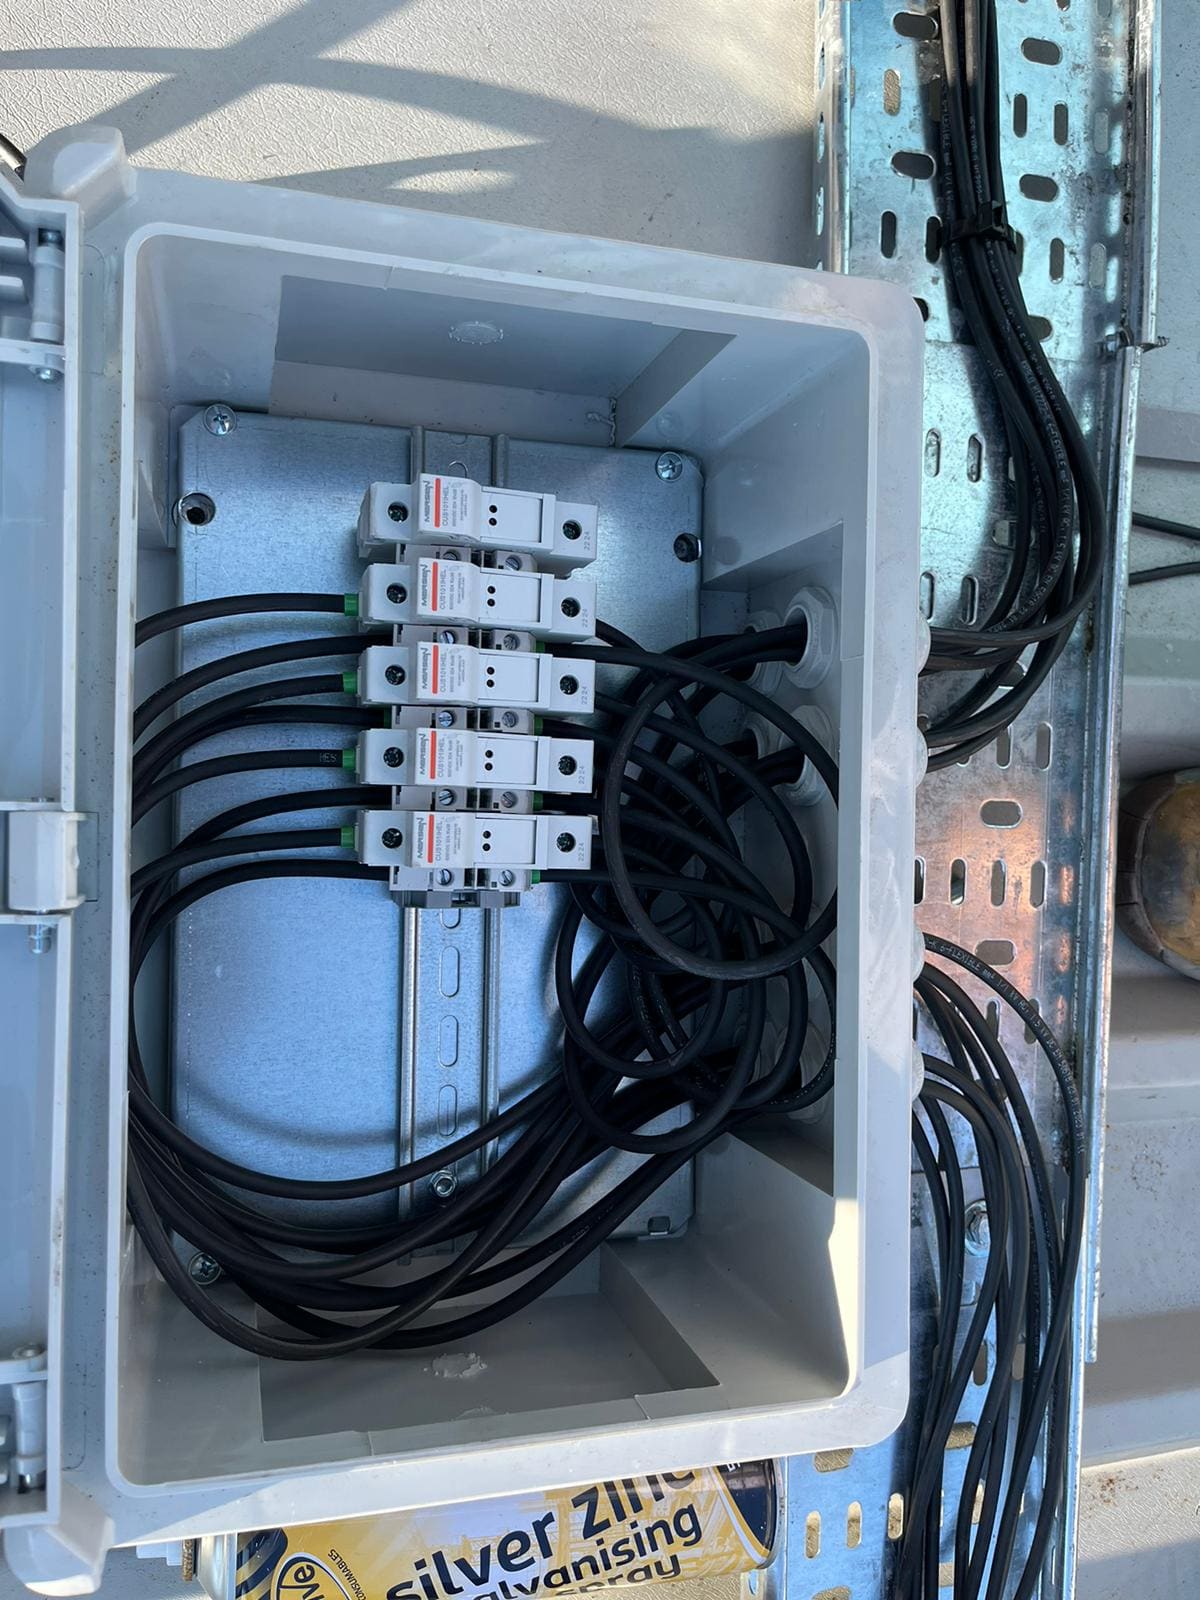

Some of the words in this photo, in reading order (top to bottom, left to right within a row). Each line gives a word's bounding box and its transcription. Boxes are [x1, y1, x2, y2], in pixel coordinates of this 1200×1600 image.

[423, 480, 433, 523] MERSEN
[420, 563, 431, 606] MERSEN
[420, 647, 431, 689] MERSEN
[418, 733, 429, 775] MERSEN
[416, 817, 427, 859] MERSEN
[386, 1511, 556, 1600] silver
[473, 1503, 703, 1600] alvanising
